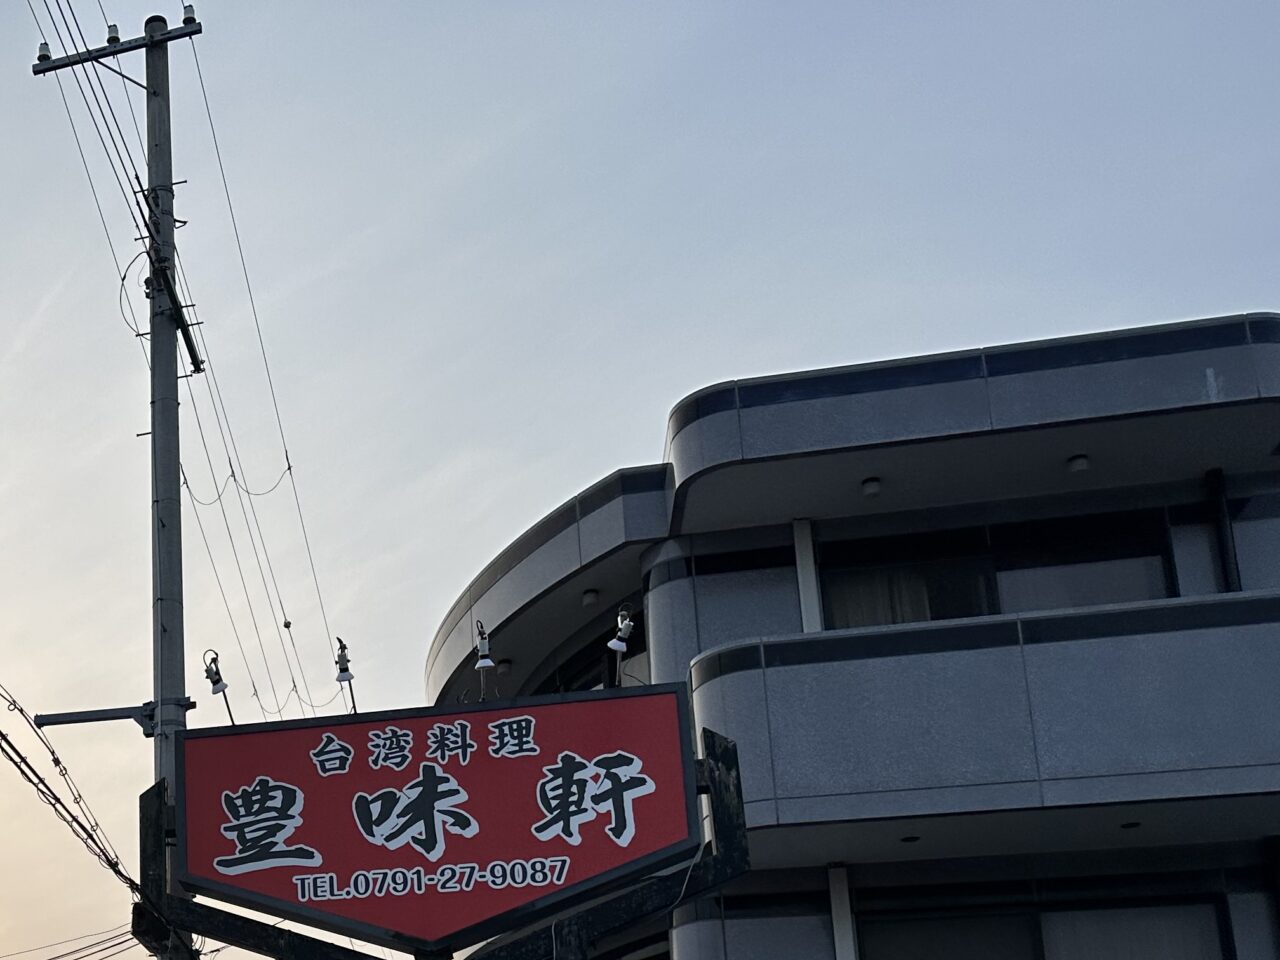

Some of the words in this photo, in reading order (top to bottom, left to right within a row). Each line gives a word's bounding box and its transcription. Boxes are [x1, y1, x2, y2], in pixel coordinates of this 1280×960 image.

[311, 717, 540, 775] 台湾料理
[214, 750, 656, 875] 豊味軒
[294, 857, 568, 901] TEL.0791-27-9087
